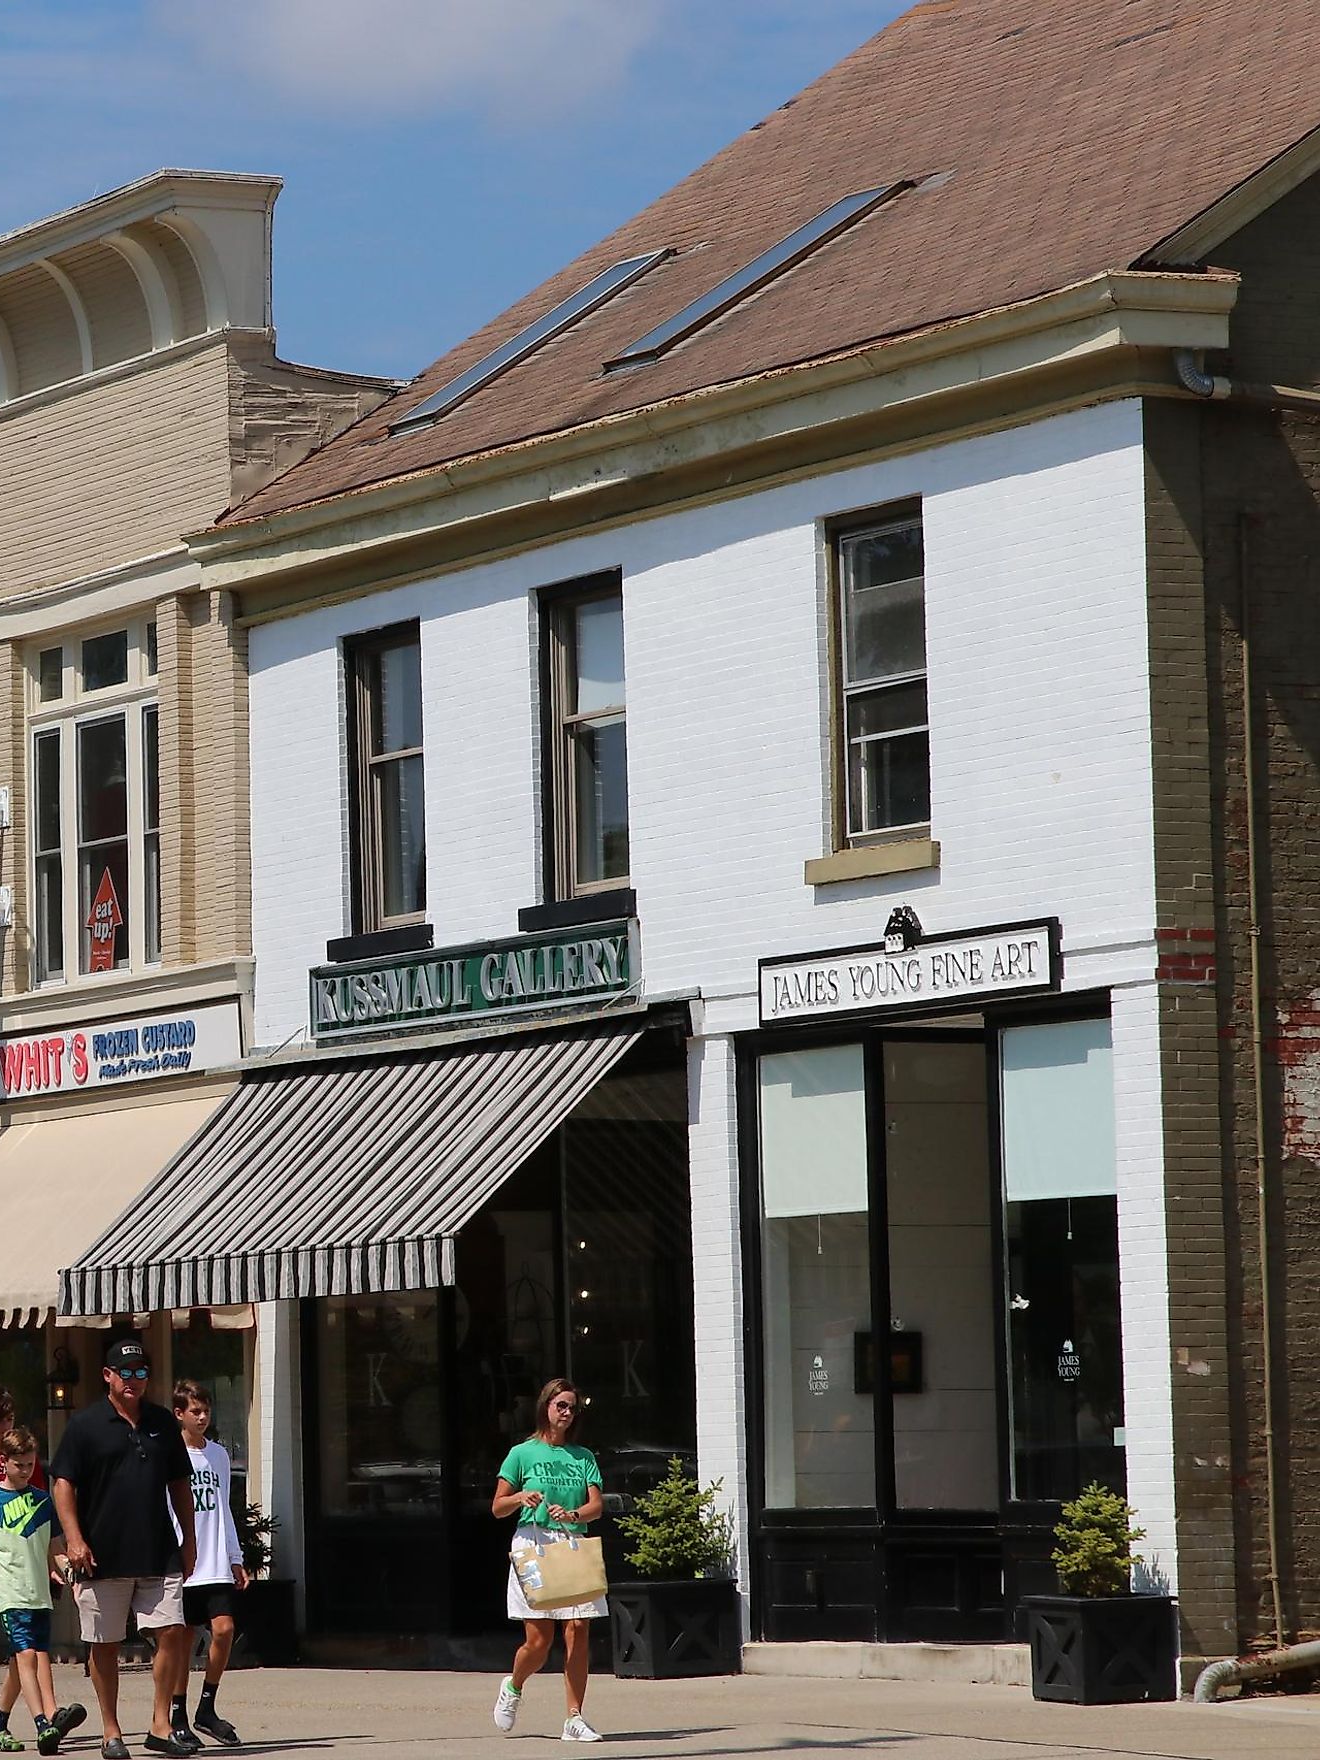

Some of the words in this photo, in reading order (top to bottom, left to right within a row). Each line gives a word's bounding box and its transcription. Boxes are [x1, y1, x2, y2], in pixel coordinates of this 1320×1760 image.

[95, 897, 114, 919] eat
[93, 919, 114, 943] up!
[316, 958, 472, 1025] KUSSMAUL
[479, 936, 630, 1001] GALLERY
[771, 969, 840, 1015] JAMES
[849, 958, 921, 1001] YOUNG
[930, 948, 984, 990] FINE
[990, 941, 1040, 982] ART
[92, 1028, 139, 1062] FROZEN
[141, 1021, 196, 1053] CUSTARD
[128, 1055, 160, 1075] Fresh
[160, 1051, 192, 1071] Daily
[620, 1339, 650, 1398] K
[1058, 1355, 1080, 1366] JAMES
[1058, 1366, 1080, 1377] YOUNG
[365, 1352, 393, 1408] K
[808, 1380, 829, 1391] YOUNG
[809, 1370, 828, 1380] JAMES
[190, 1470, 220, 1488] RISH
[539, 1477, 583, 1487] COUNTRY
[2, 1491, 35, 1525] NIKE
[192, 1487, 216, 1512] XC
